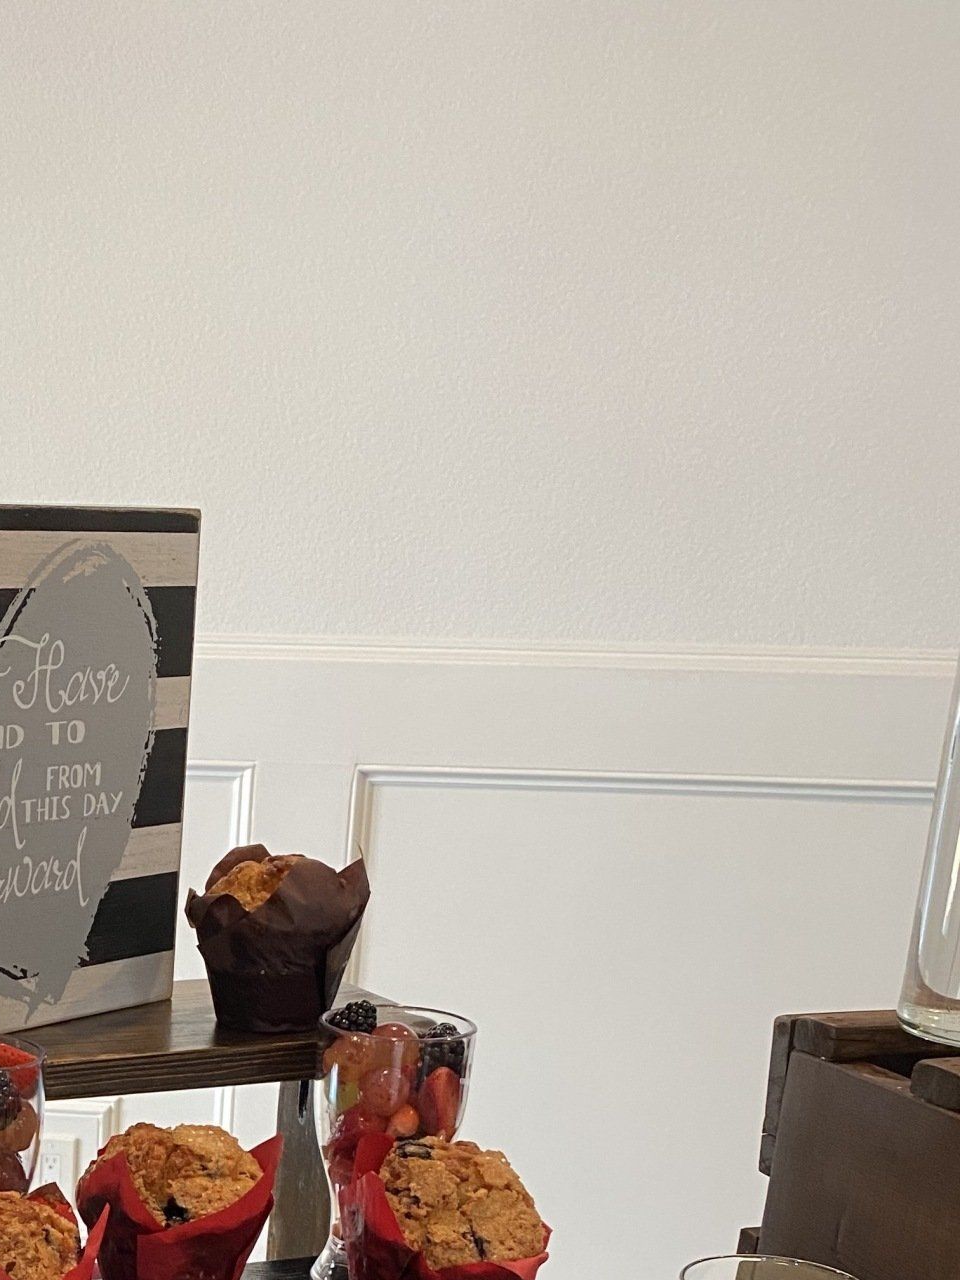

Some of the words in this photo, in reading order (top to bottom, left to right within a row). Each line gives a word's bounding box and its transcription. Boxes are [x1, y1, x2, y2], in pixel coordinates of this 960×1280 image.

[45, 720, 86, 745] TO
[46, 761, 102, 792] FROM
[22, 795, 71, 824] THIS
[83, 791, 123, 816] DAY
